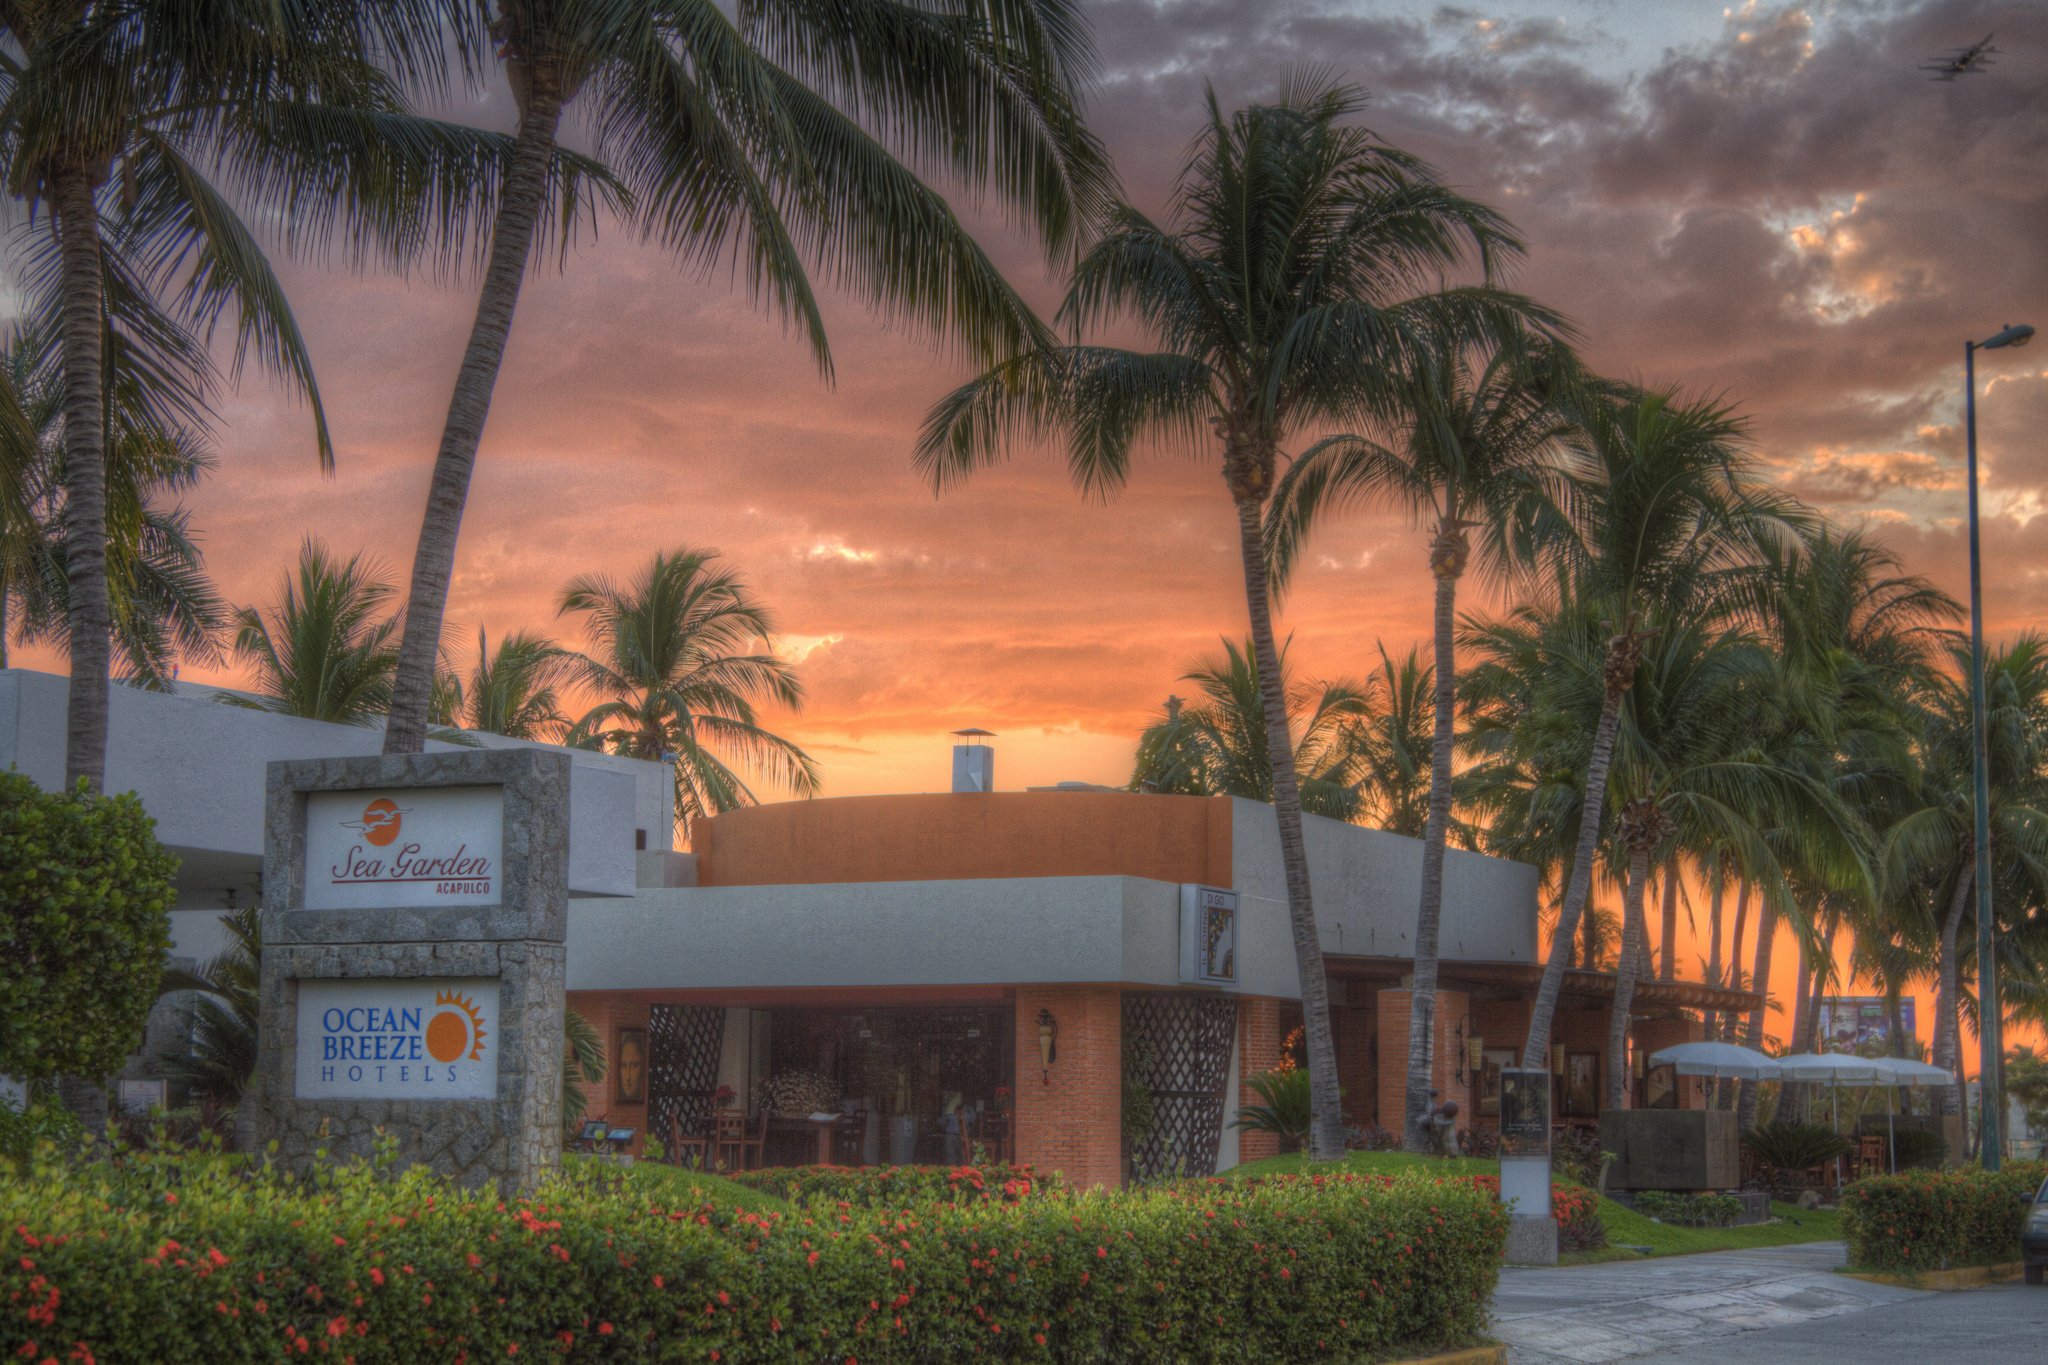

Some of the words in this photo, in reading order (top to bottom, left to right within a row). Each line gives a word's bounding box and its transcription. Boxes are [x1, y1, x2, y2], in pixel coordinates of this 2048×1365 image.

[332, 845, 386, 878] Sea
[390, 842, 492, 878] Garden
[436, 882, 491, 895] ACAPULCO
[323, 1007, 422, 1033] OCEAN
[322, 1036, 423, 1061] BREEZE
[321, 1065, 457, 1082] HOTELS
